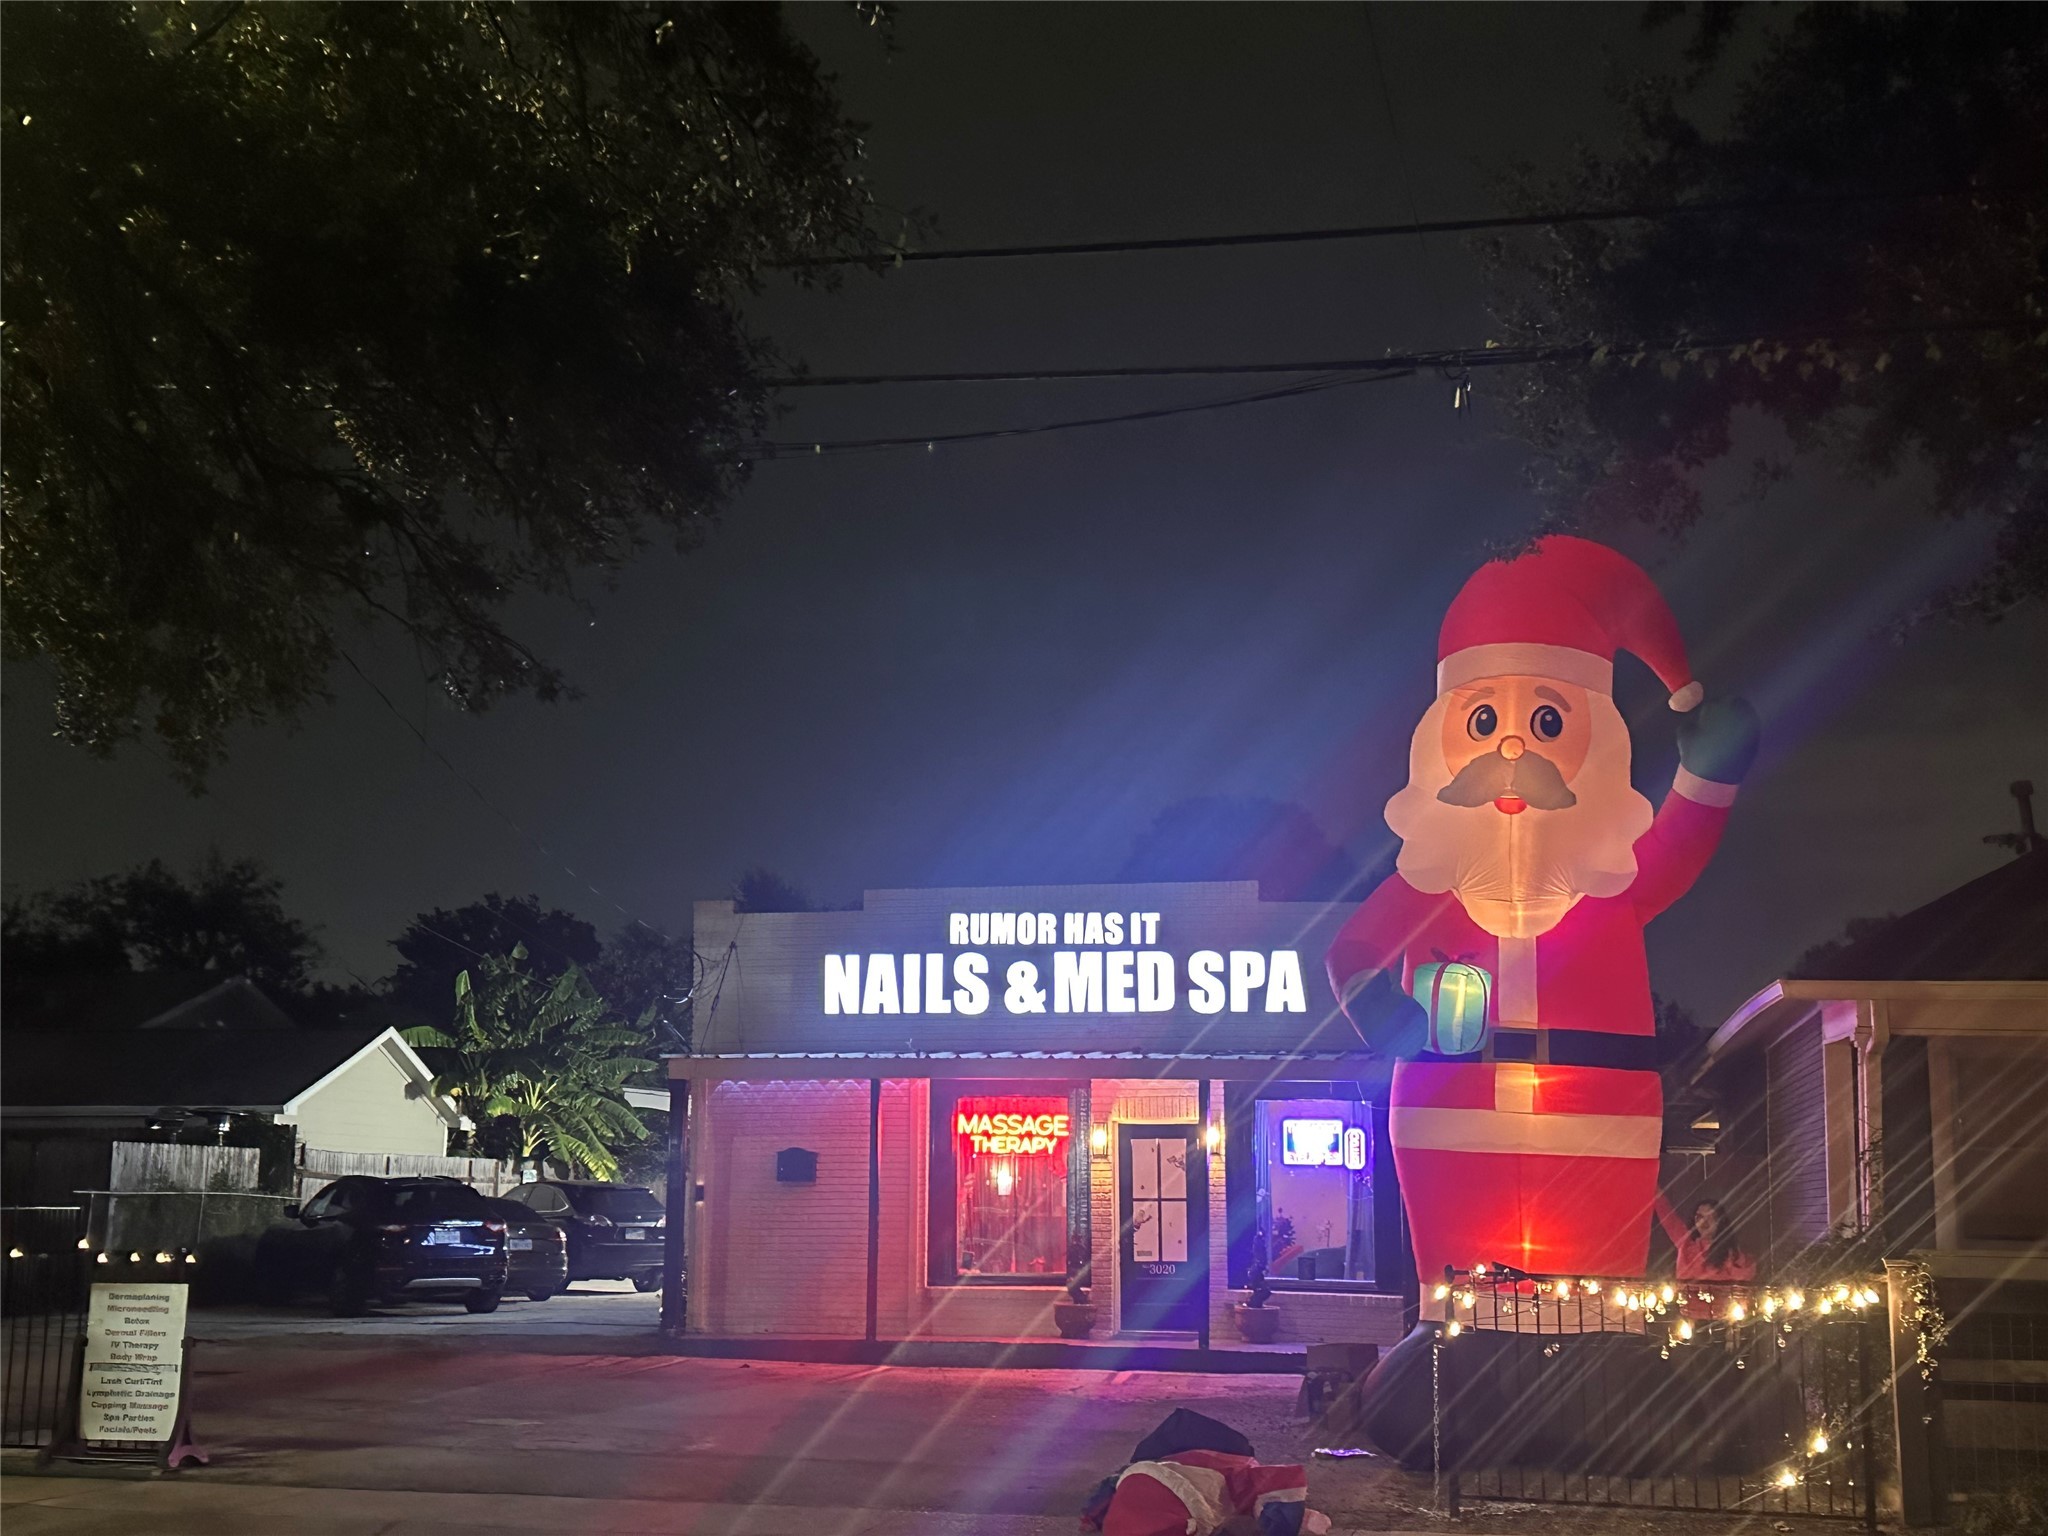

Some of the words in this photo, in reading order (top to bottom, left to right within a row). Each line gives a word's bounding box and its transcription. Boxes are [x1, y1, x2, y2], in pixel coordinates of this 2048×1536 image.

[949, 912, 1057, 946] RUMOR
[1063, 912, 1125, 946] HAS
[1130, 912, 1160, 945] IT
[823, 952, 990, 1015] NAILS
[1003, 959, 1047, 1015] &
[1052, 950, 1175, 1014] MED
[1186, 950, 1307, 1014] SPA
[957, 1113, 1070, 1137] MASSAGE
[970, 1135, 1057, 1155] THERAPY
[1149, 1264, 1176, 1275] 3020
[108, 1293, 170, 1302] Dermaplaning
[107, 1305, 169, 1314] Microneedling
[124, 1317, 150, 1325] Botox
[104, 1328, 137, 1337] Dermal
[139, 1329, 167, 1337] Fillers
[110, 1341, 121, 1349] IV
[122, 1341, 159, 1351] Therapy
[110, 1352, 133, 1362] Body
[134, 1353, 158, 1362] Wrap
[100, 1377, 122, 1385] Lash
[86, 1389, 133, 1398] Lymphatic
[135, 1390, 176, 1399] Drainage
[91, 1401, 127, 1410] Cupping
[129, 1402, 169, 1411] Massage
[103, 1413, 120, 1422] Spa
[122, 1413, 155, 1422] Parties
